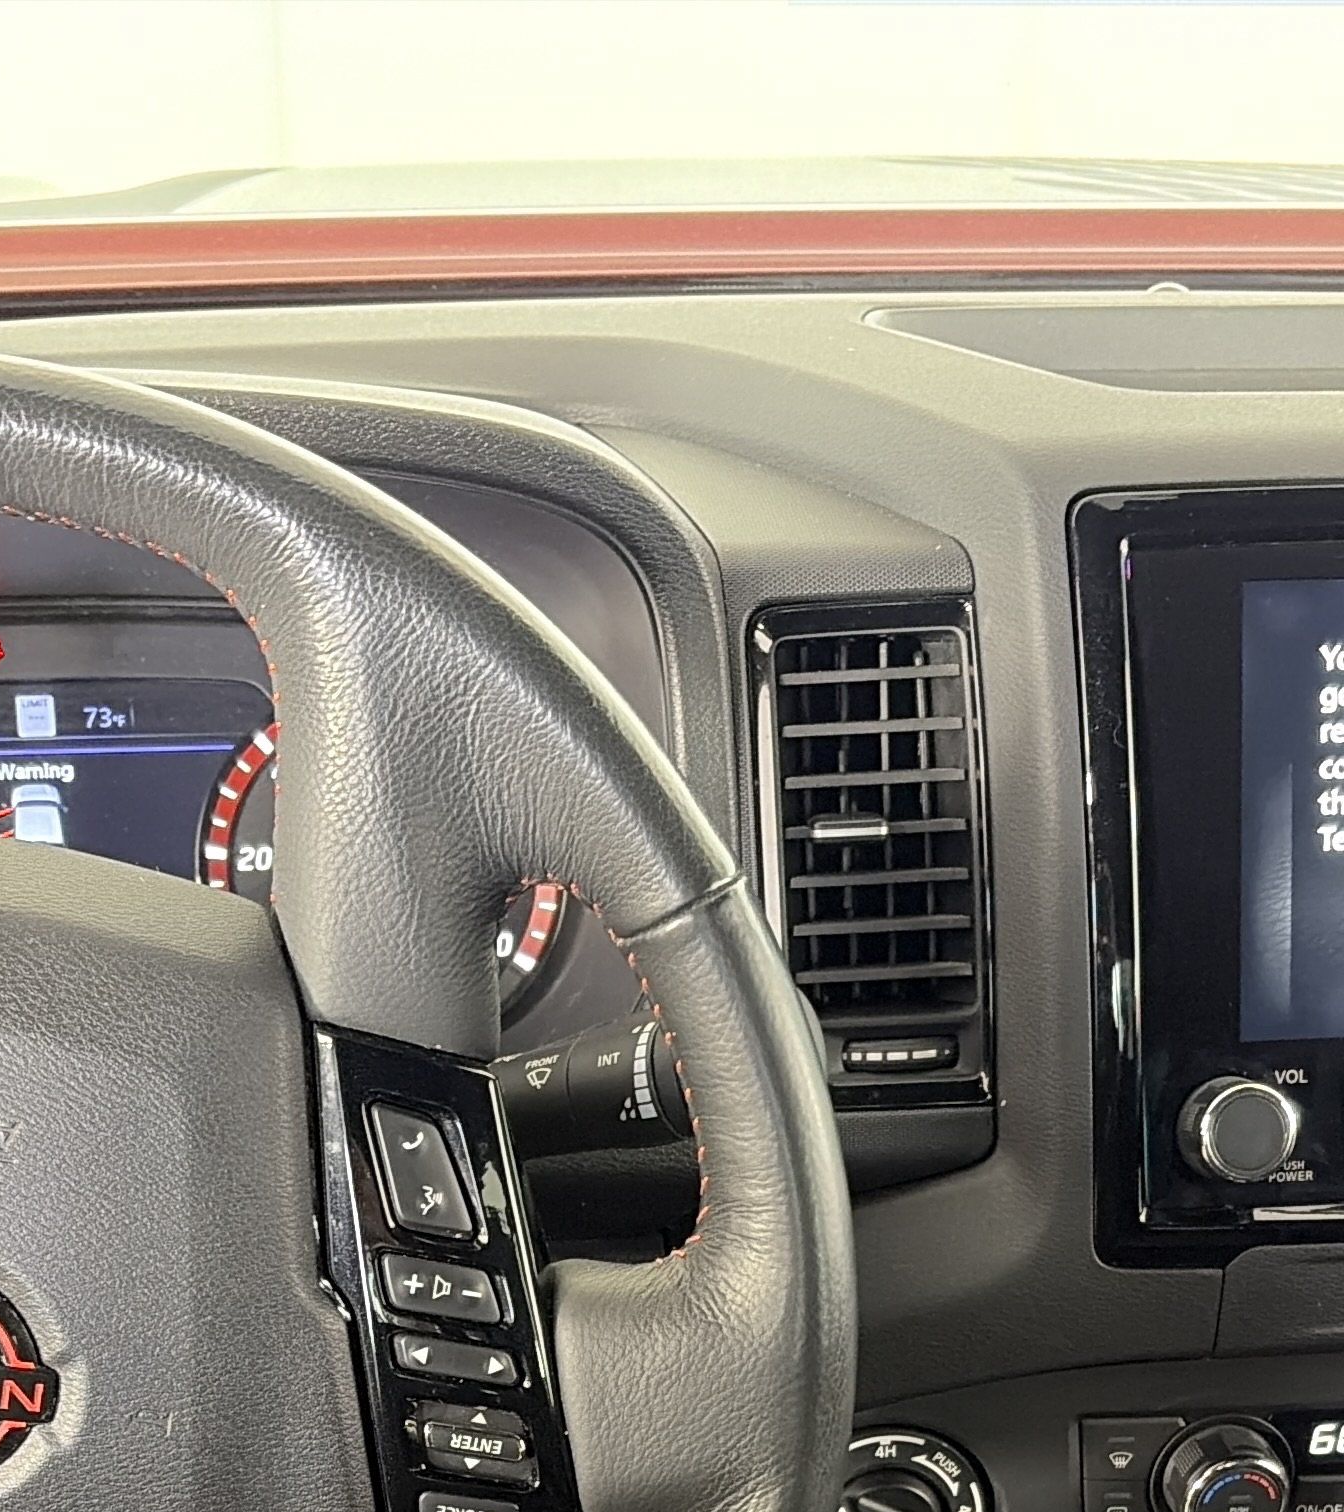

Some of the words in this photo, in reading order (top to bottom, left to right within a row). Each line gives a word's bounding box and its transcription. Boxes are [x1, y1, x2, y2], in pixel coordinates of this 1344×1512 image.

[524, 1054, 560, 1070] FRONT
[597, 1052, 621, 1068] INT
[1274, 1069, 1308, 1085] VOL
[1283, 1160, 1305, 1171] USH
[1269, 1170, 1314, 1183] POWER
[450, 1433, 503, 1455] ENTER
[875, 1445, 896, 1458] 4H
[932, 1451, 962, 1478] PUSH
